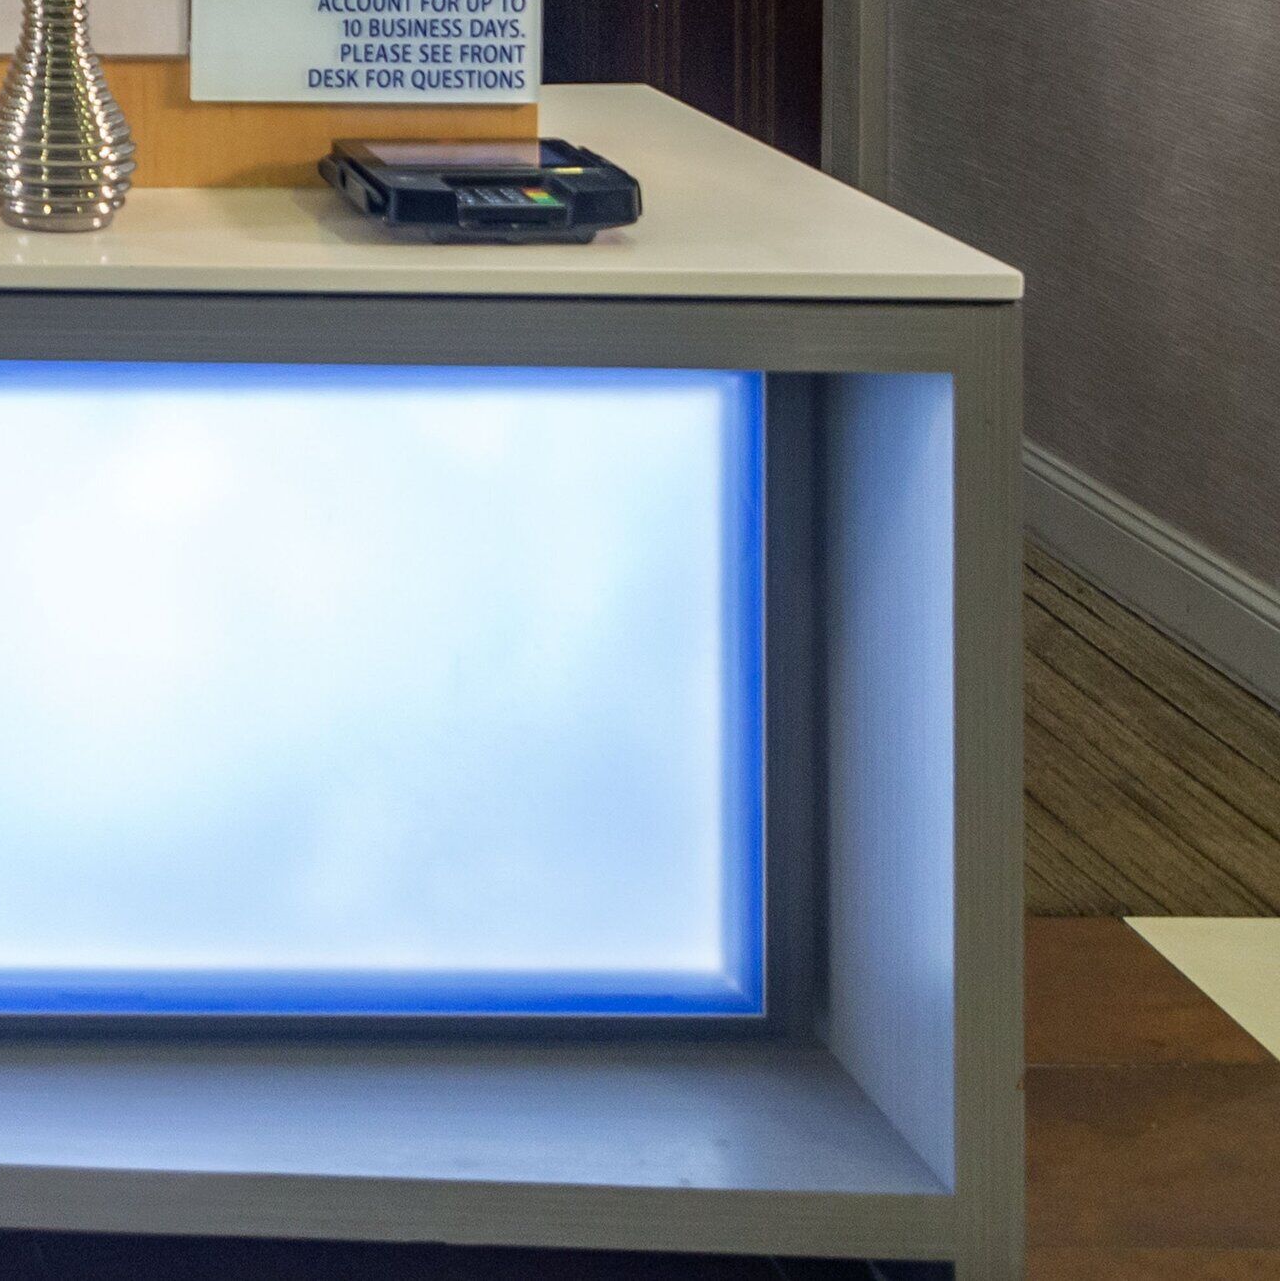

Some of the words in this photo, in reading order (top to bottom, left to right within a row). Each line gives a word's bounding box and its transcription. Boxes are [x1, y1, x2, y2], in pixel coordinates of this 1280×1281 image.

[343, 19, 361, 38] 10
[369, 19, 462, 38] BUSINESS
[470, 19, 526, 38] DAYS.
[340, 44, 412, 63] PLEASE
[419, 44, 452, 63] SEE
[460, 44, 525, 63] FRONT
[308, 69, 358, 88] DESK
[366, 69, 404, 88] FOR
[411, 69, 525, 90] QUESTIONS
